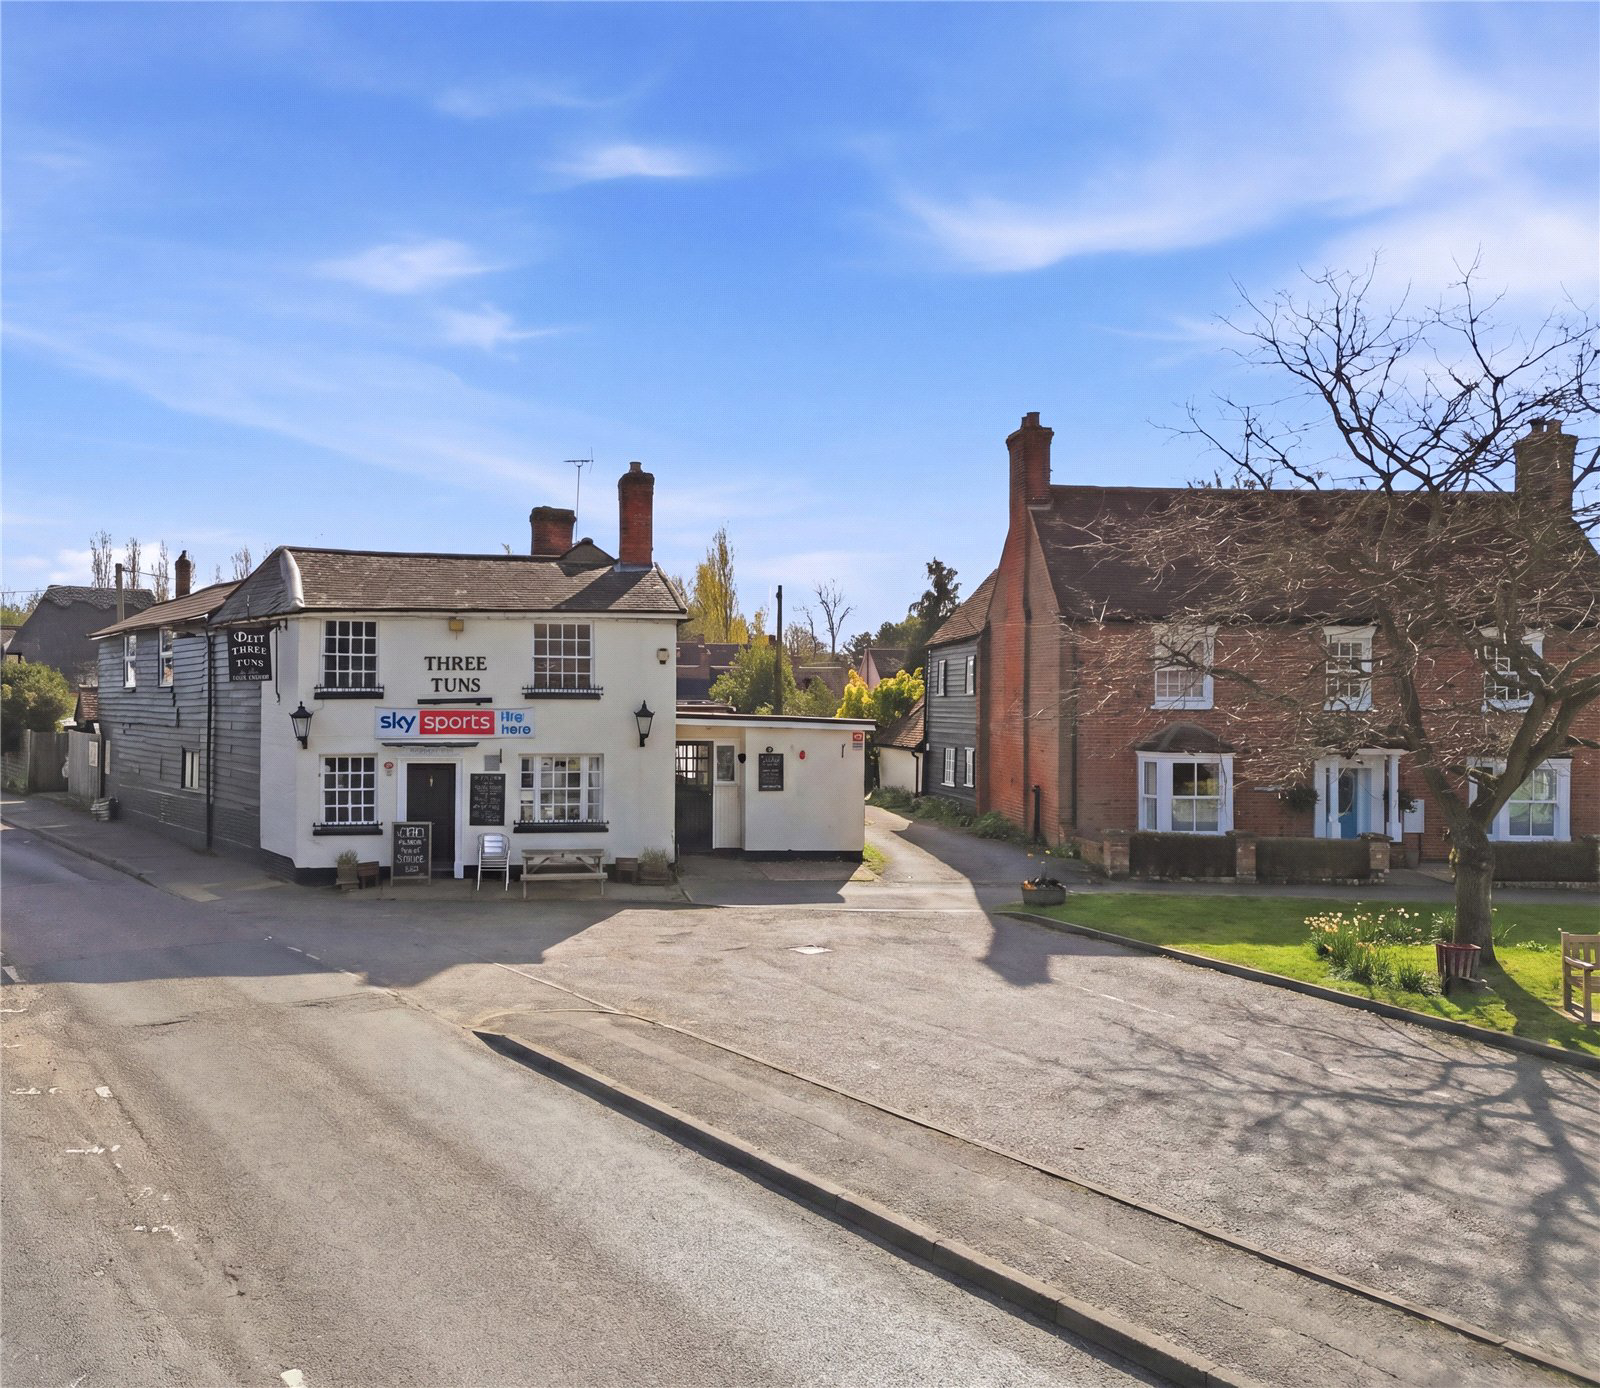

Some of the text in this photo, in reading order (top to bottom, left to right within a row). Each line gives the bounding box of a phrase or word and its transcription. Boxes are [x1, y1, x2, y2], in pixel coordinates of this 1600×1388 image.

[231, 645, 267, 655] THREE
[236, 658, 264, 667] TUNS
[424, 656, 488, 671] THREE
[431, 677, 481, 692] TUNS
[380, 711, 491, 733] sky sports
[501, 724, 531, 735] here
